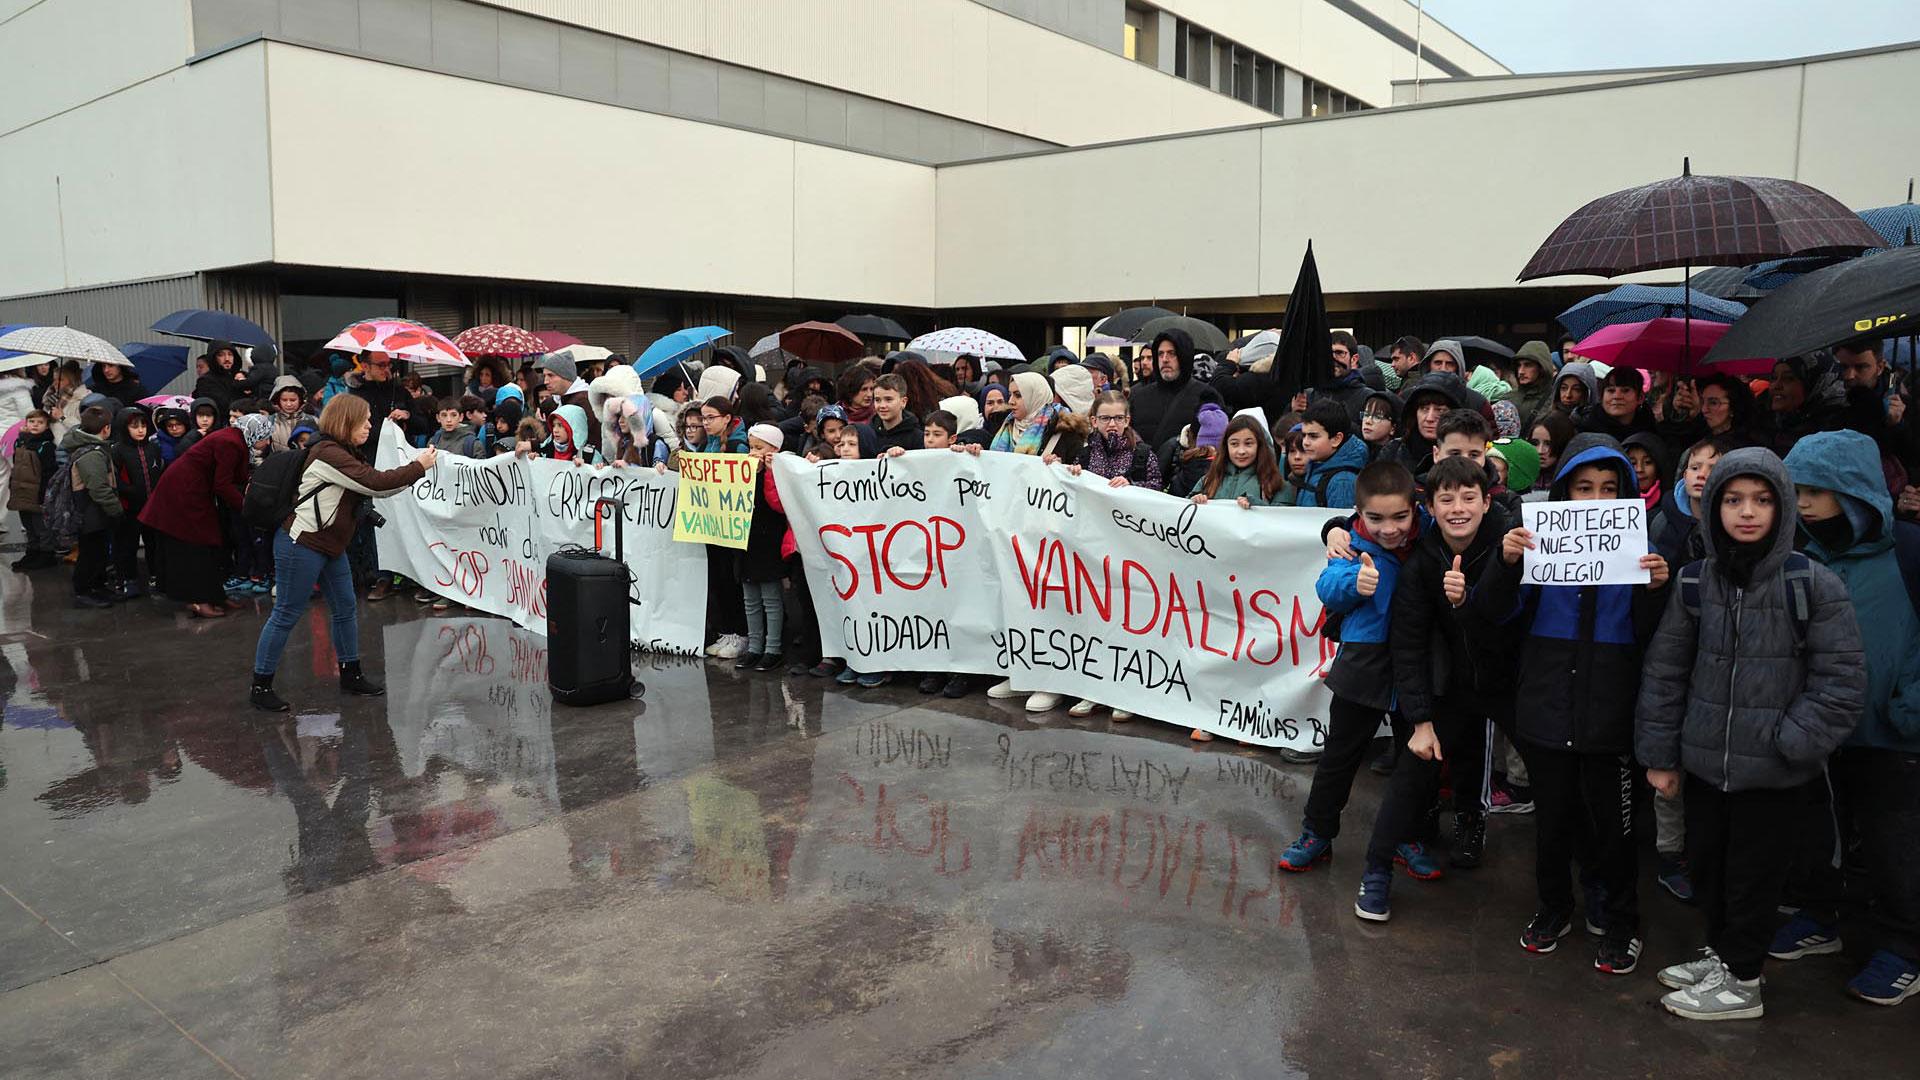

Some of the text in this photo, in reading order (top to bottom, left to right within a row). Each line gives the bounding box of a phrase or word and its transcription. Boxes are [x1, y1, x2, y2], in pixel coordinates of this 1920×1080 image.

[679, 457, 752, 484] RESPETO
[690, 486, 753, 513] NO MAS
[817, 458, 1216, 559] Familias por una escuela
[1536, 506, 1640, 532] PROTEGER
[1540, 535, 1621, 555] NUESTRO
[818, 515, 1336, 678] STOP VANDALiSM
[1008, 628, 1192, 702] RESPETADA
